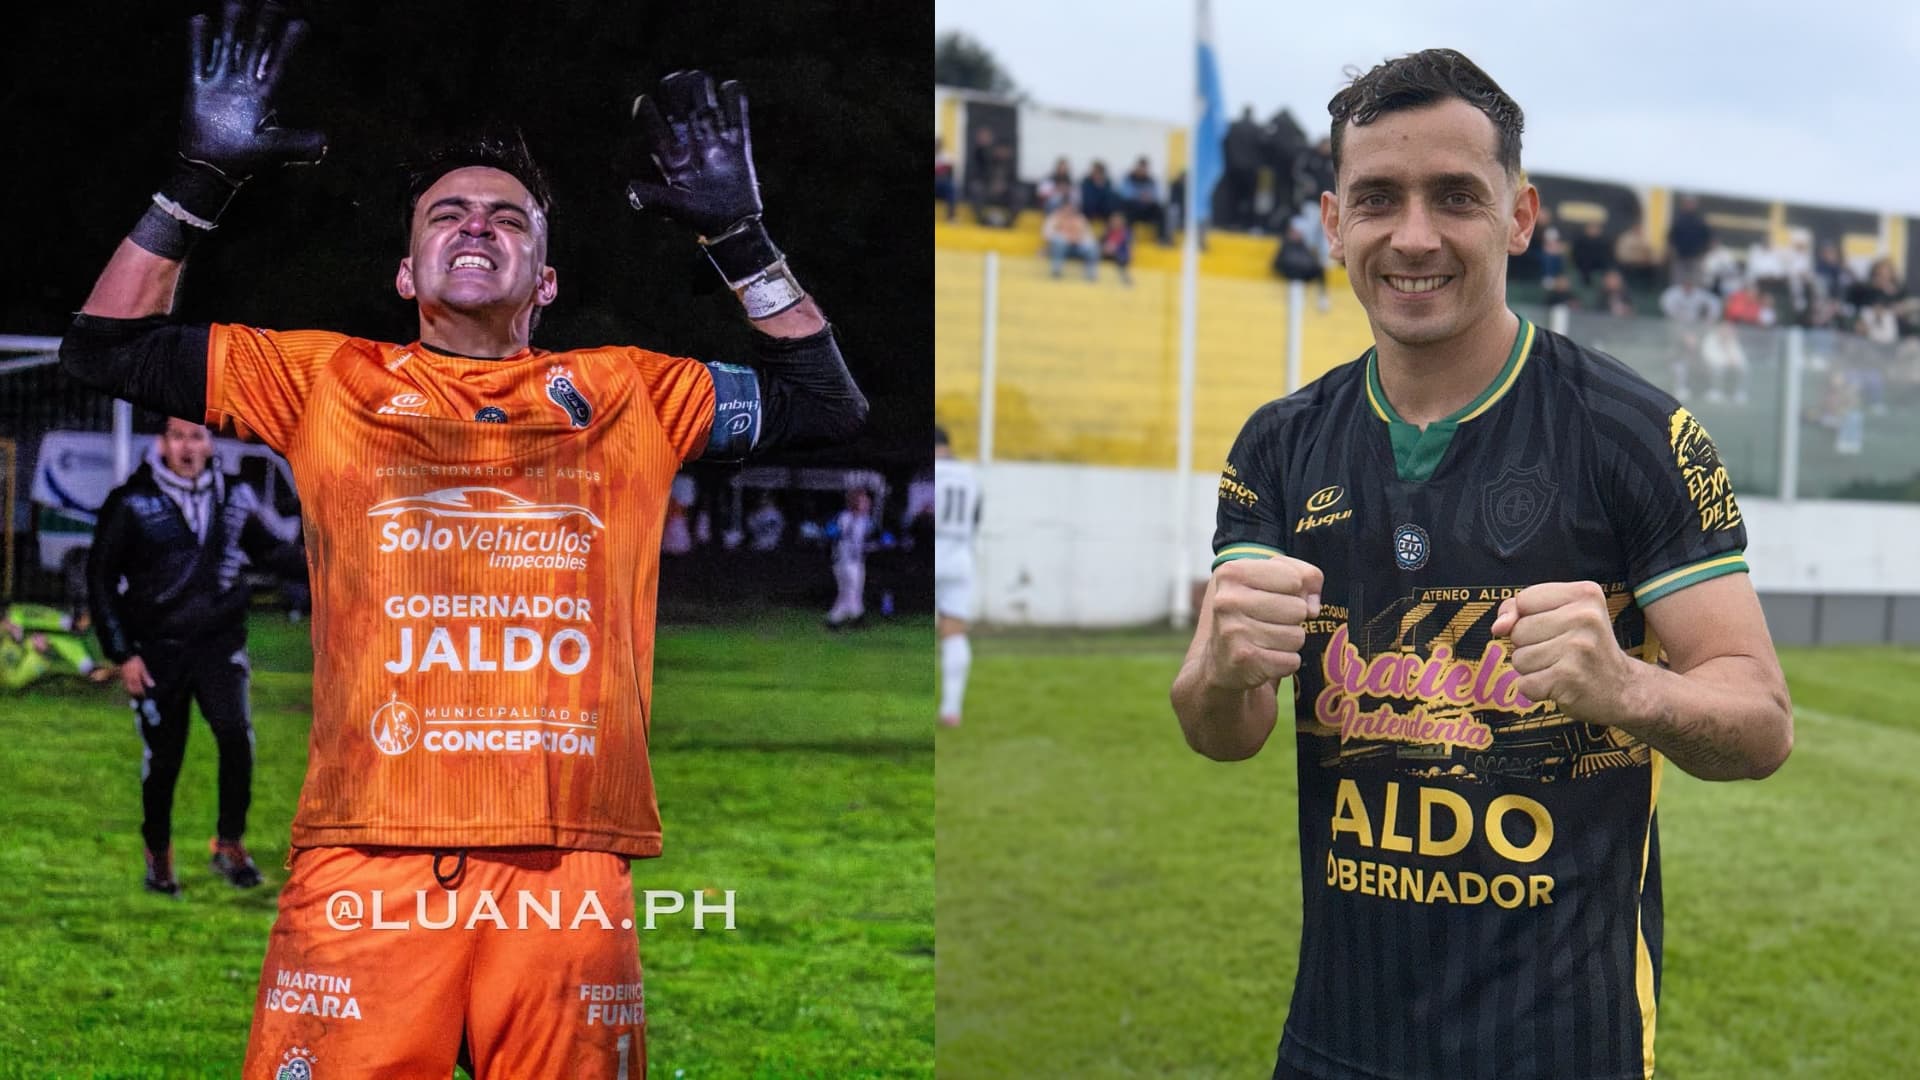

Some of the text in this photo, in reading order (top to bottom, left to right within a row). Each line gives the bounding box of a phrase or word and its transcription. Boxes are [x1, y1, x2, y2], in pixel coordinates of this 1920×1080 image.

[376, 466, 601, 481] CONCESIONARIO DE AUTOS
[944, 486, 965, 524] 11
[380, 520, 453, 553] Solo
[489, 551, 587, 570] Impecables
[384, 594, 592, 622] GOBERNADOR
[1422, 589, 1470, 600] ATENEO
[384, 626, 591, 676] JALDO
[425, 707, 598, 723] MUNICIPALIDAD DE
[423, 728, 596, 756] CONCEPCIÓN
[1331, 778, 1554, 863] ALDO
[276, 969, 352, 994] MARTIN
